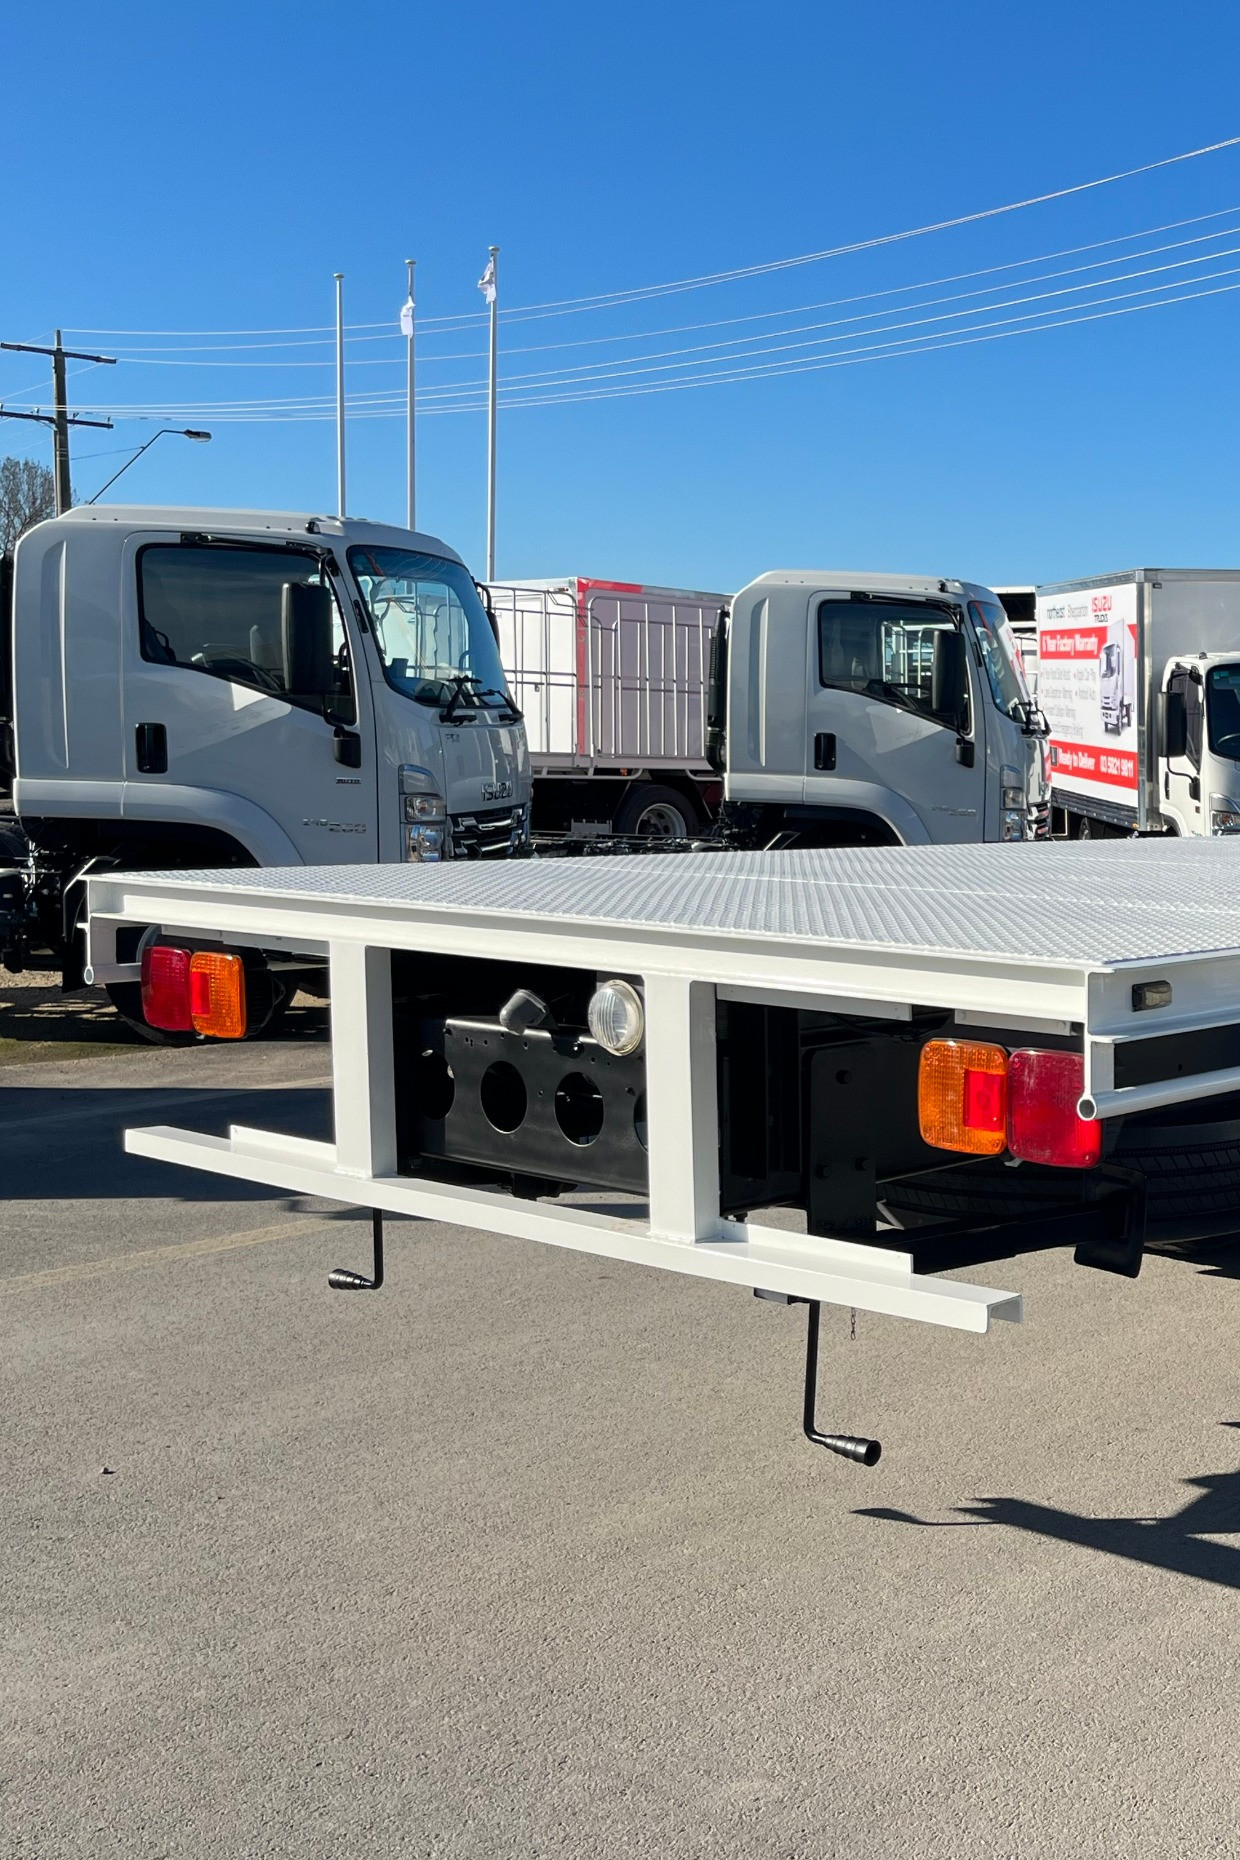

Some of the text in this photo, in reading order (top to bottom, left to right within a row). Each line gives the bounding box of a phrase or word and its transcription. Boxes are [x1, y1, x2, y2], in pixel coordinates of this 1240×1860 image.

[1091, 595, 1113, 613] ISUZU
[1047, 634, 1057, 652] Year
[1057, 634, 1075, 656] Factory
[1075, 633, 1099, 656] Warranty
[1058, 748, 1096, 771] Ready to Deliver
[481, 780, 514, 801] ISUZU
